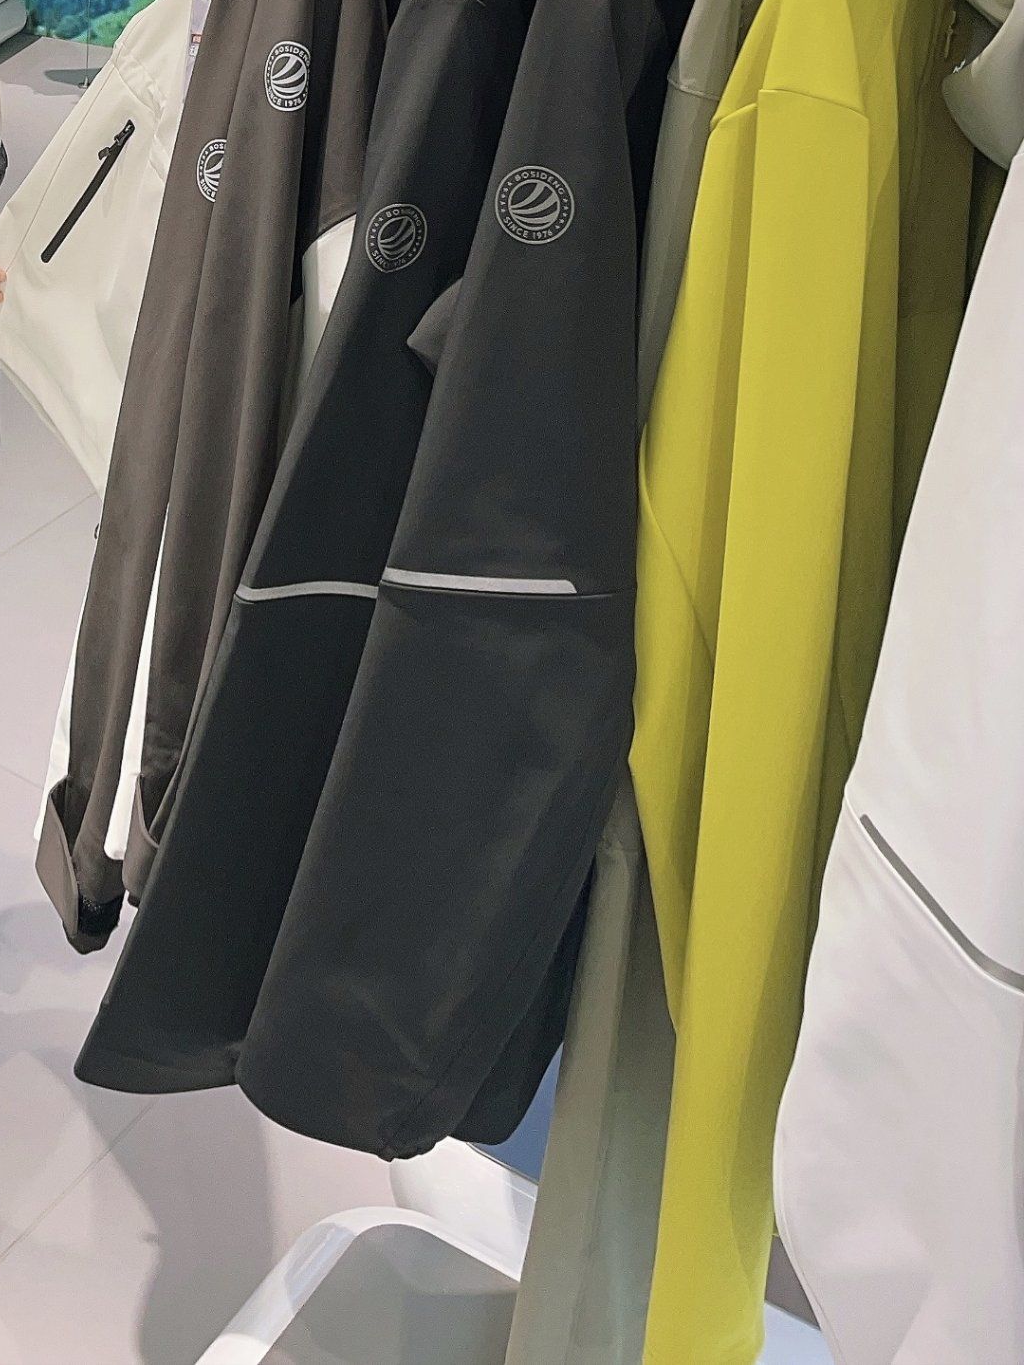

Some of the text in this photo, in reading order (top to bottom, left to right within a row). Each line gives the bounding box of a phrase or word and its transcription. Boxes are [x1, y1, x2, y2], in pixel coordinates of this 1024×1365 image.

[274, 45, 311, 67] BOSIDENG
[514, 170, 565, 195] BOSIDENG
[503, 216, 554, 240] SINCE 1976
